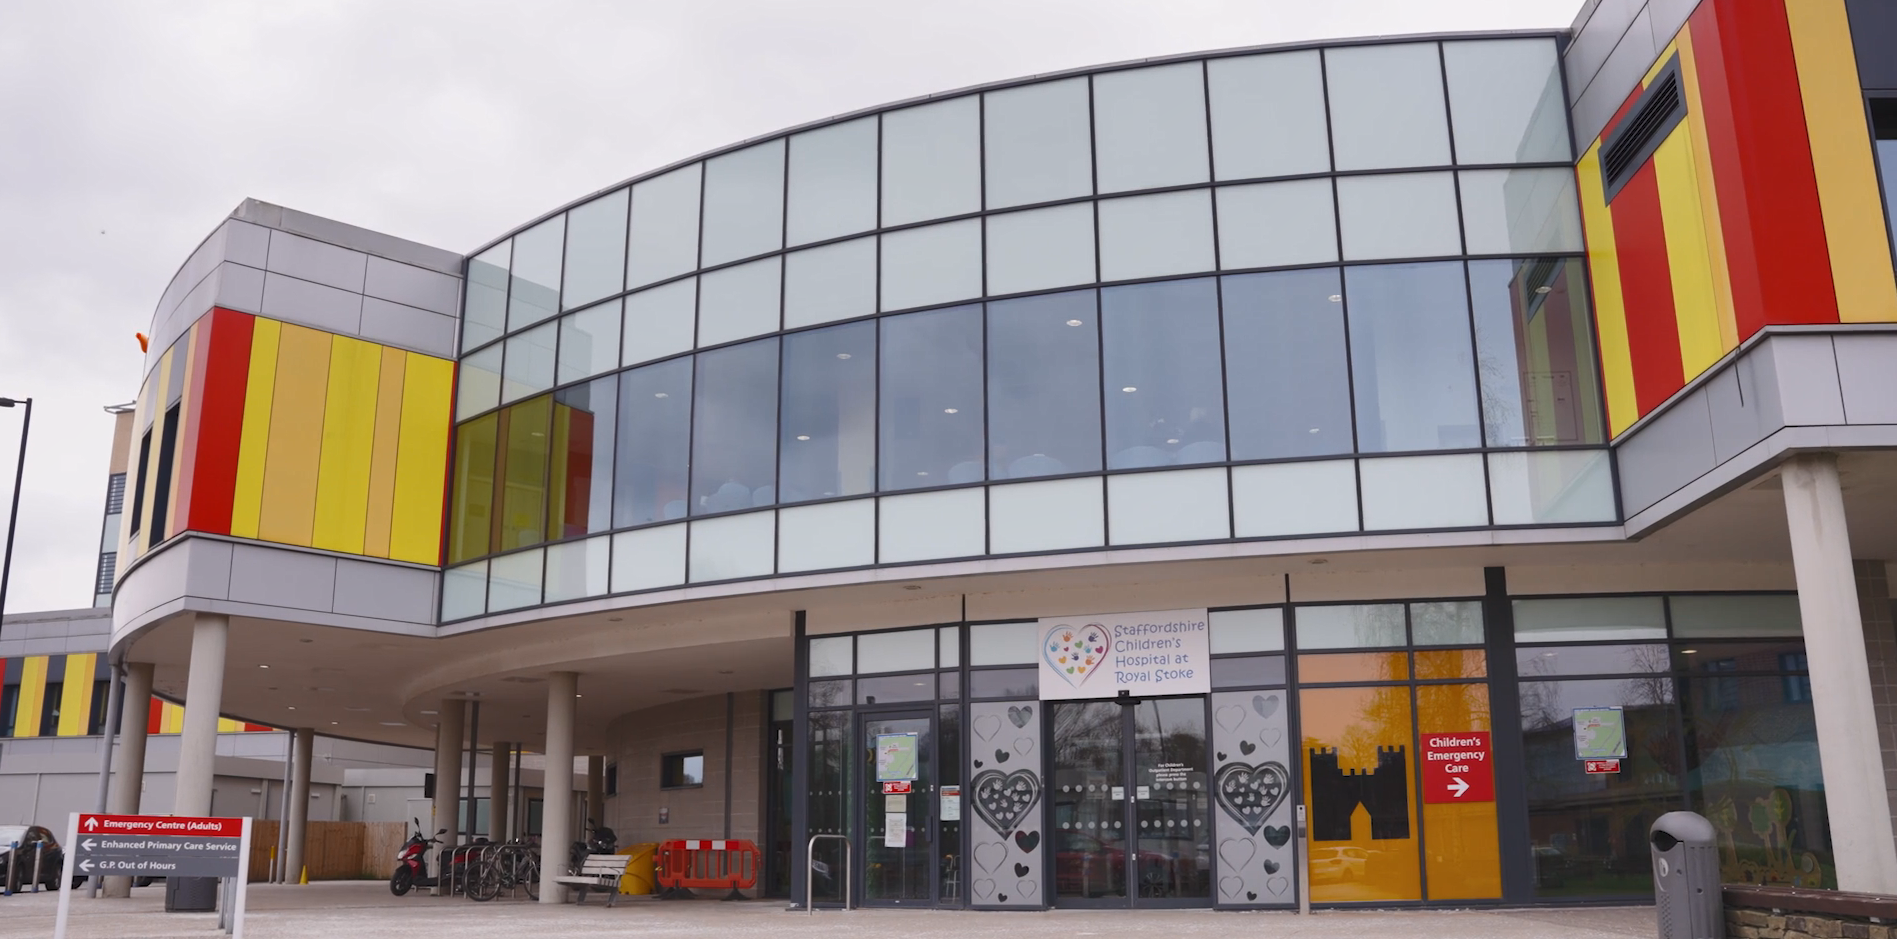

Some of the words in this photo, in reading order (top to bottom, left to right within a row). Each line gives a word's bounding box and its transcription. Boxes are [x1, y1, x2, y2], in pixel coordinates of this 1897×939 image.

[1114, 621, 1205, 638] Staffordshire
[1115, 637, 1182, 652] Children's
[1116, 654, 1170, 668] Hospital
[1175, 654, 1189, 663] at
[1114, 671, 1150, 684] Royal
[1155, 669, 1194, 683] Stoke
[1429, 737, 1481, 747] Children's
[1427, 751, 1485, 762] Emergency
[1445, 763, 1469, 773] Care
[103, 819, 154, 831] Emergency
[155, 821, 186, 830] Centre
[186, 821, 222, 831] (Adults)
[101, 840, 145, 849] Enhanced
[148, 842, 182, 851] Primary
[183, 842, 204, 850] Care
[205, 843, 237, 851] Service
[99, 861, 116, 869] G.P.
[118, 861, 136, 869] Out
[137, 861, 148, 869] of
[149, 862, 176, 870] Hours
